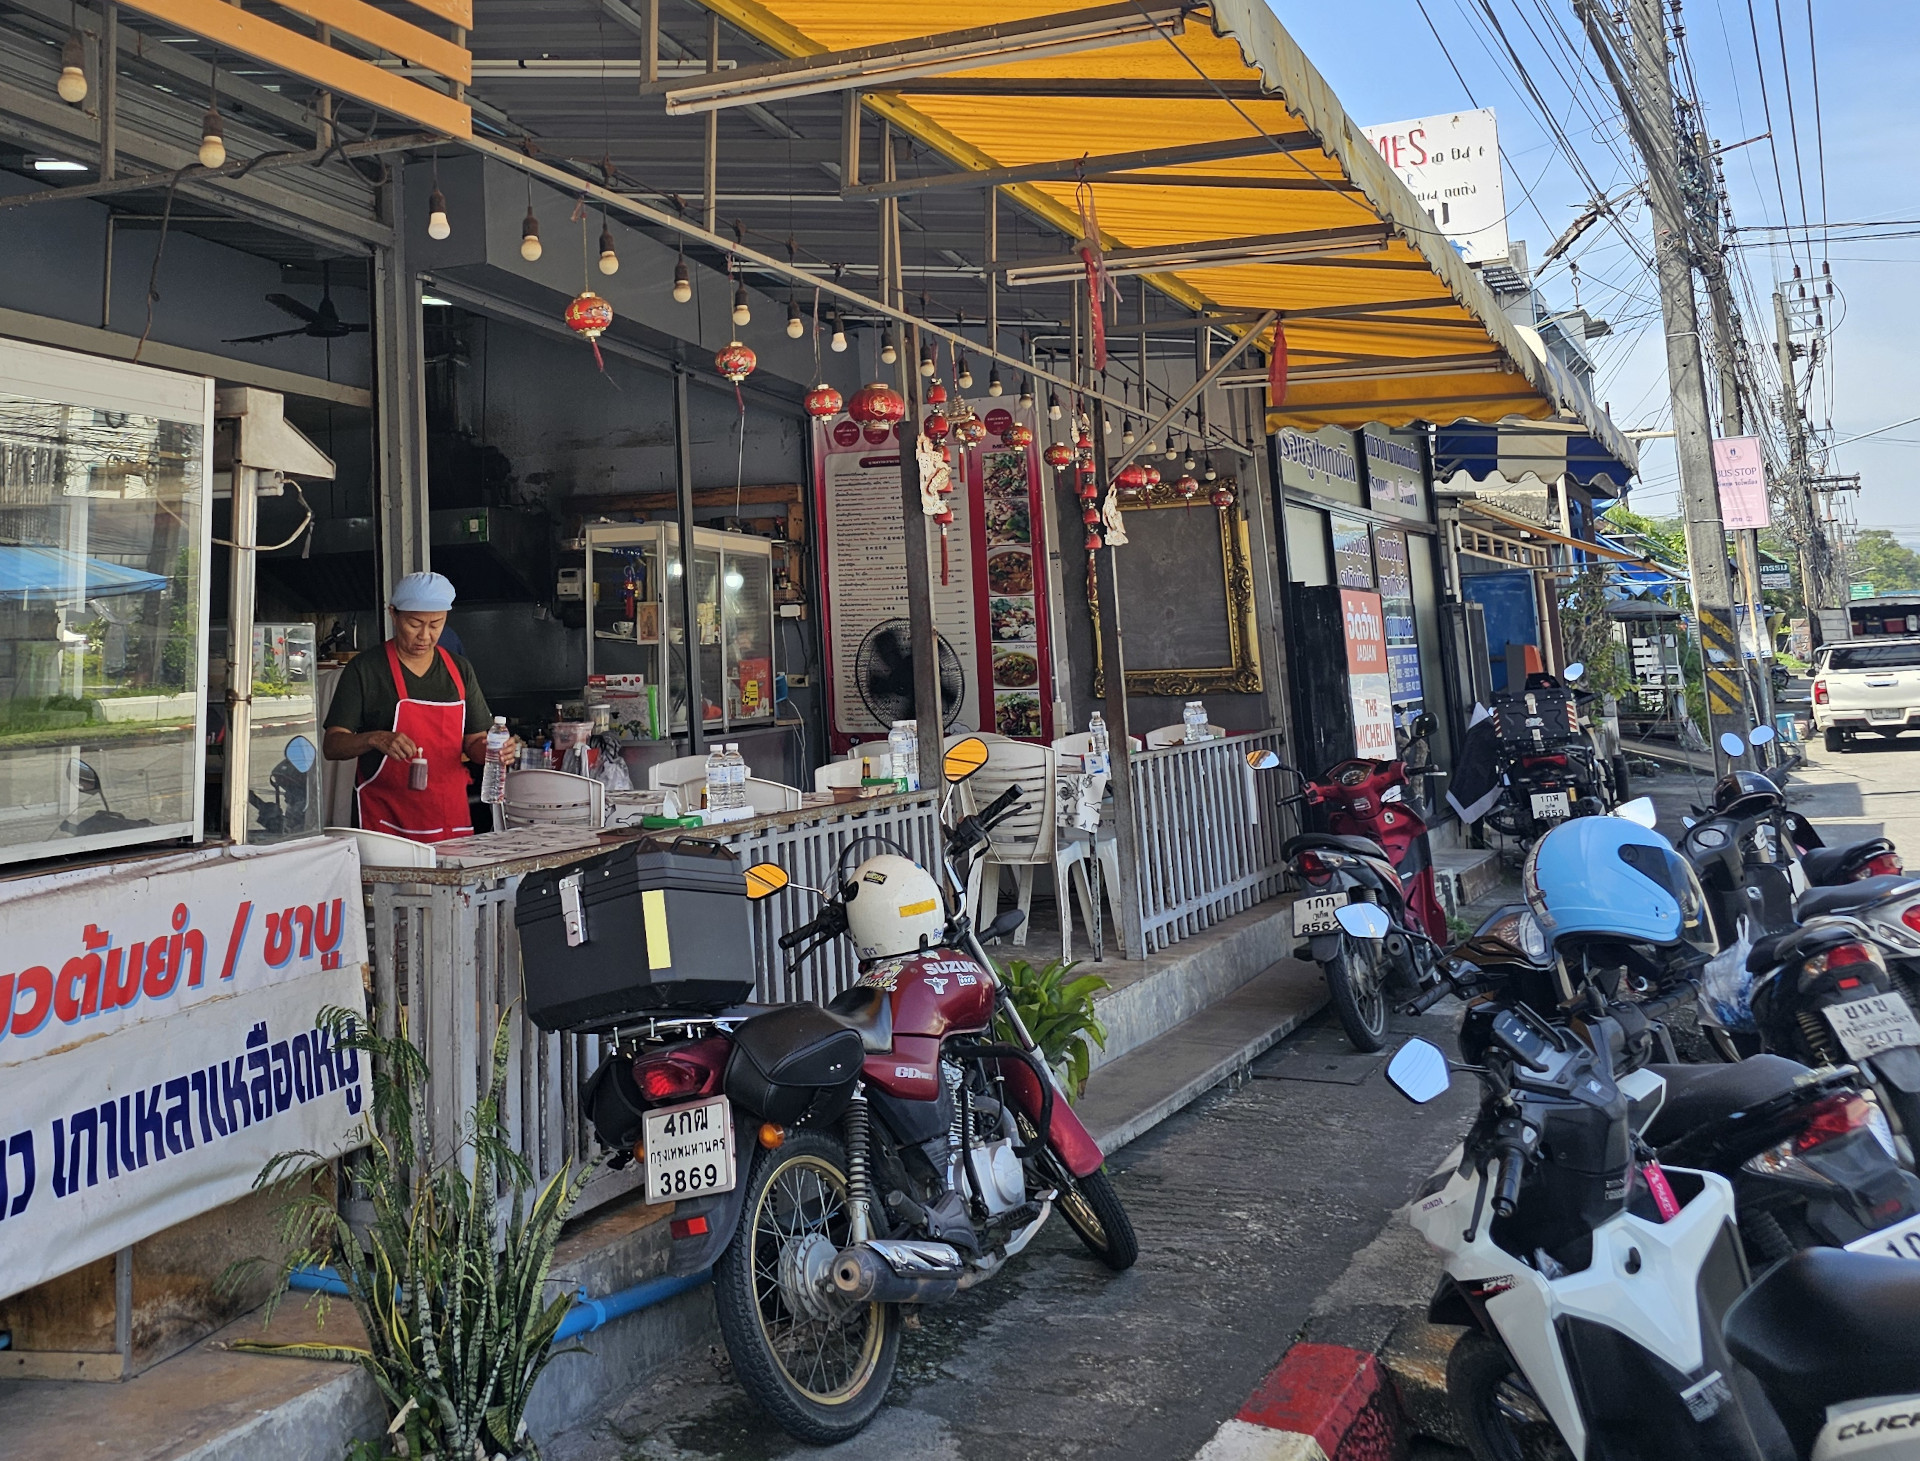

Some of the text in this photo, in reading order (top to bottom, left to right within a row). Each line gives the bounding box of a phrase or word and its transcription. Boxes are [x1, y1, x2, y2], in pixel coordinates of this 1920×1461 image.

[1279, 429, 1357, 486] รอบรูปทุกชนิด
[1734, 467, 1757, 477] STOP
[1365, 699, 1378, 718] THE
[1355, 723, 1393, 751] MICHELIN
[262, 897, 346, 971] ชาบู
[922, 960, 983, 976] SUZUKI
[650, 1138, 726, 1168] กรุงเทพมหานคร
[660, 1163, 718, 1196] 3869
[1422, 1197, 1444, 1212] HONDA
